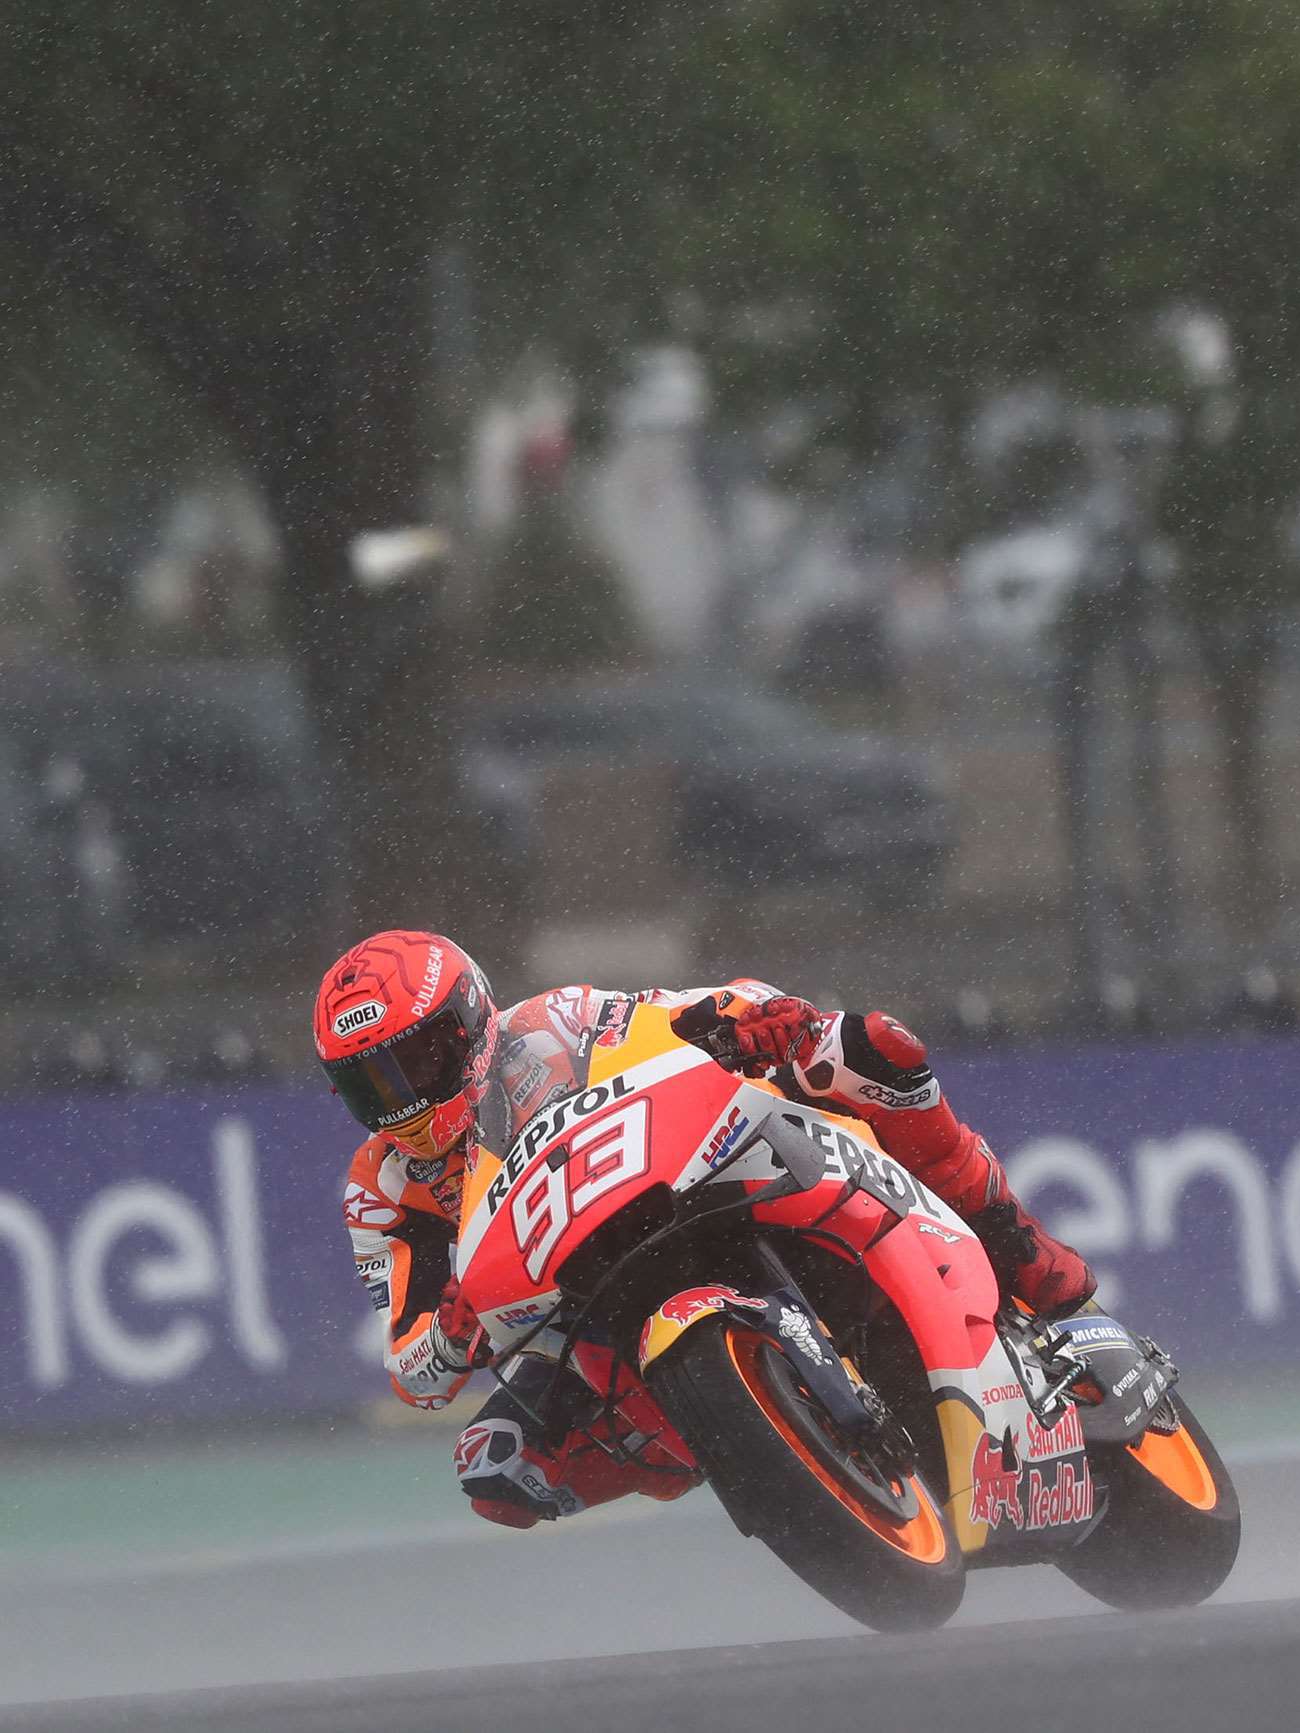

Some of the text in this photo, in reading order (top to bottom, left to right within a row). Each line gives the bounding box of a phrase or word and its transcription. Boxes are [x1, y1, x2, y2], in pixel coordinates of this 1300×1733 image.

[411, 945, 443, 1018] PULL&BEAR
[337, 1004, 379, 1034] SHOEI
[357, 1046, 378, 1061] YOU
[382, 1024, 421, 1049] WINGS
[377, 1097, 431, 1127] PULL&BEAR
[486, 1076, 635, 1216] REPSOL
[511, 1098, 651, 1284] 93
[782, 1113, 942, 1220] EPSOL
